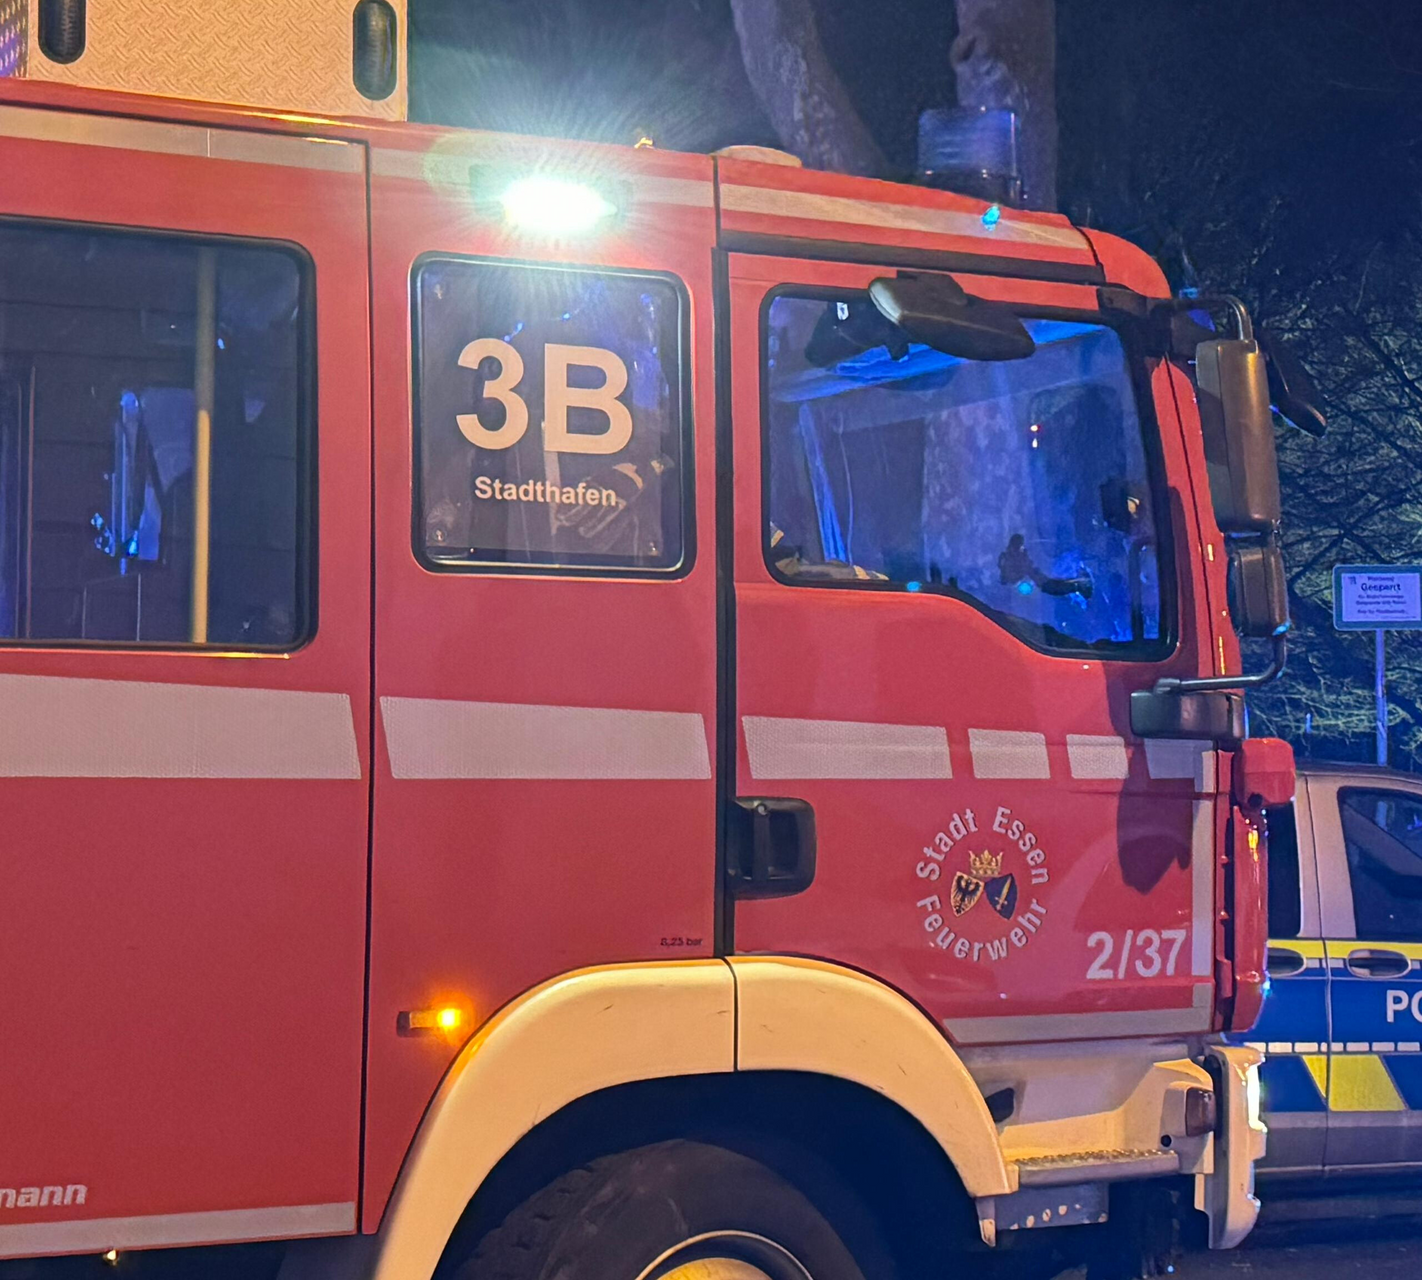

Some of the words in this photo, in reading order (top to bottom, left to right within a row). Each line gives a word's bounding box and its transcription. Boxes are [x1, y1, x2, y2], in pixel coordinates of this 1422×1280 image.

[456, 338, 633, 455] 3B
[474, 476, 617, 506] Stadthafen
[916, 808, 979, 881] Stadt
[993, 806, 1049, 885] Essen
[916, 895, 1048, 962] Feuerwehr
[1086, 929, 1187, 979] 2/37
